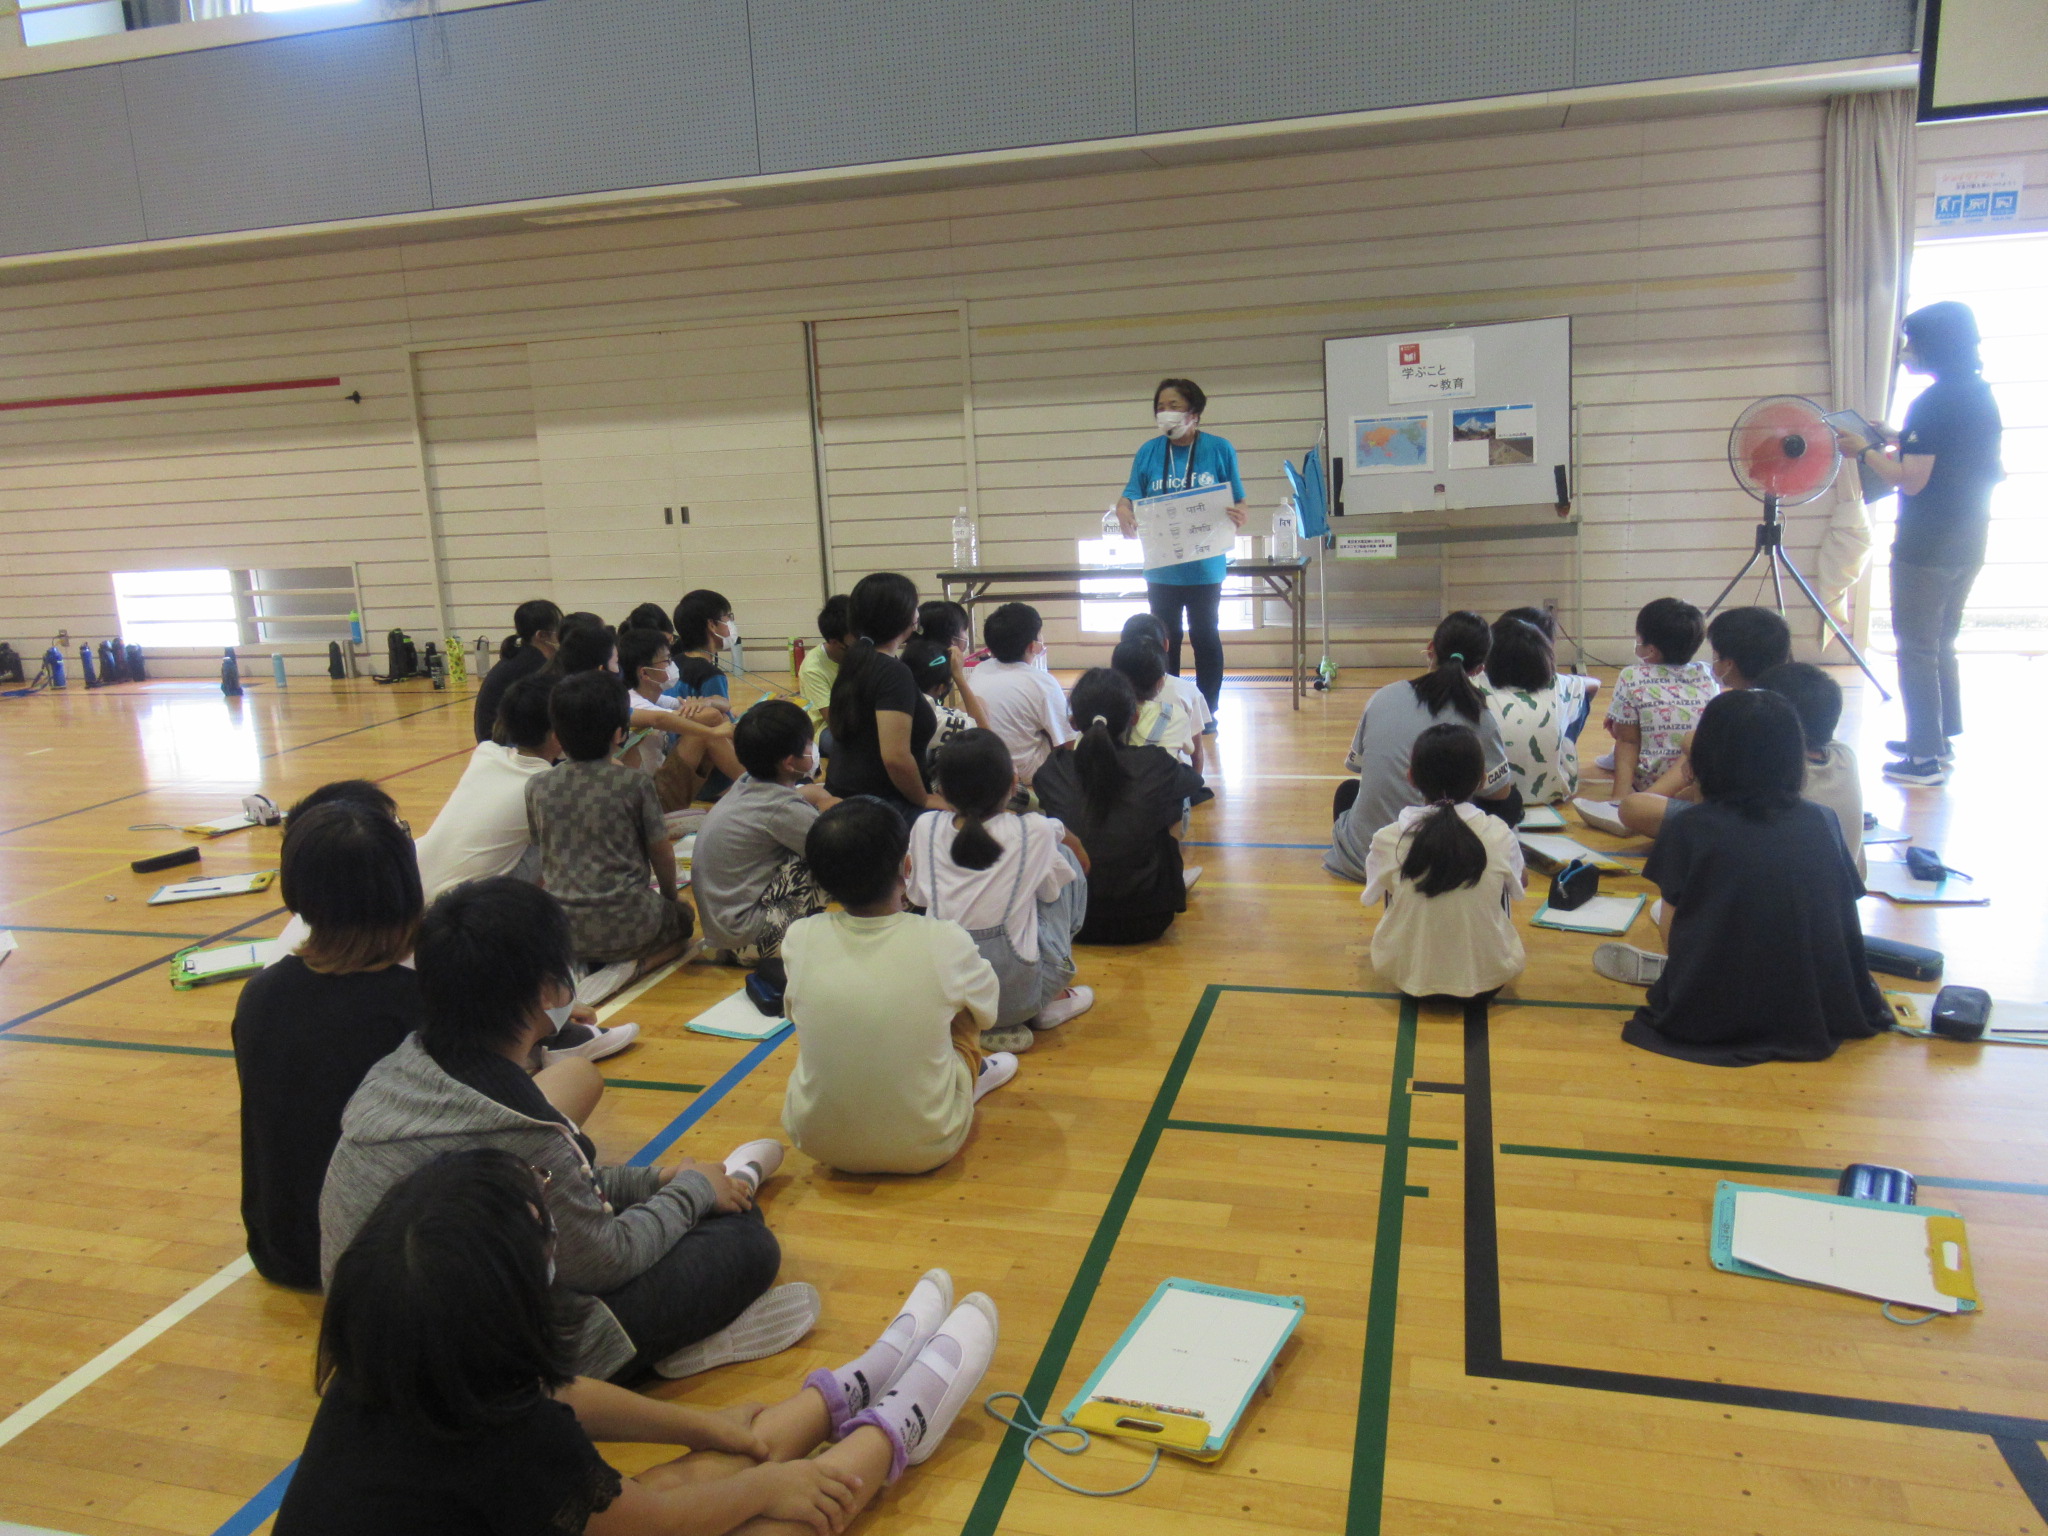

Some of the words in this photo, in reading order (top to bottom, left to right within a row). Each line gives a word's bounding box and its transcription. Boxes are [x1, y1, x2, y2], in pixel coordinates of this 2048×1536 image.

[1402, 364, 1446, 379] 学ぶこと
[1152, 472, 1197, 491] unicef
[1638, 677, 1670, 685] MAIZEN
[1658, 723, 1692, 731] MAIZEN
